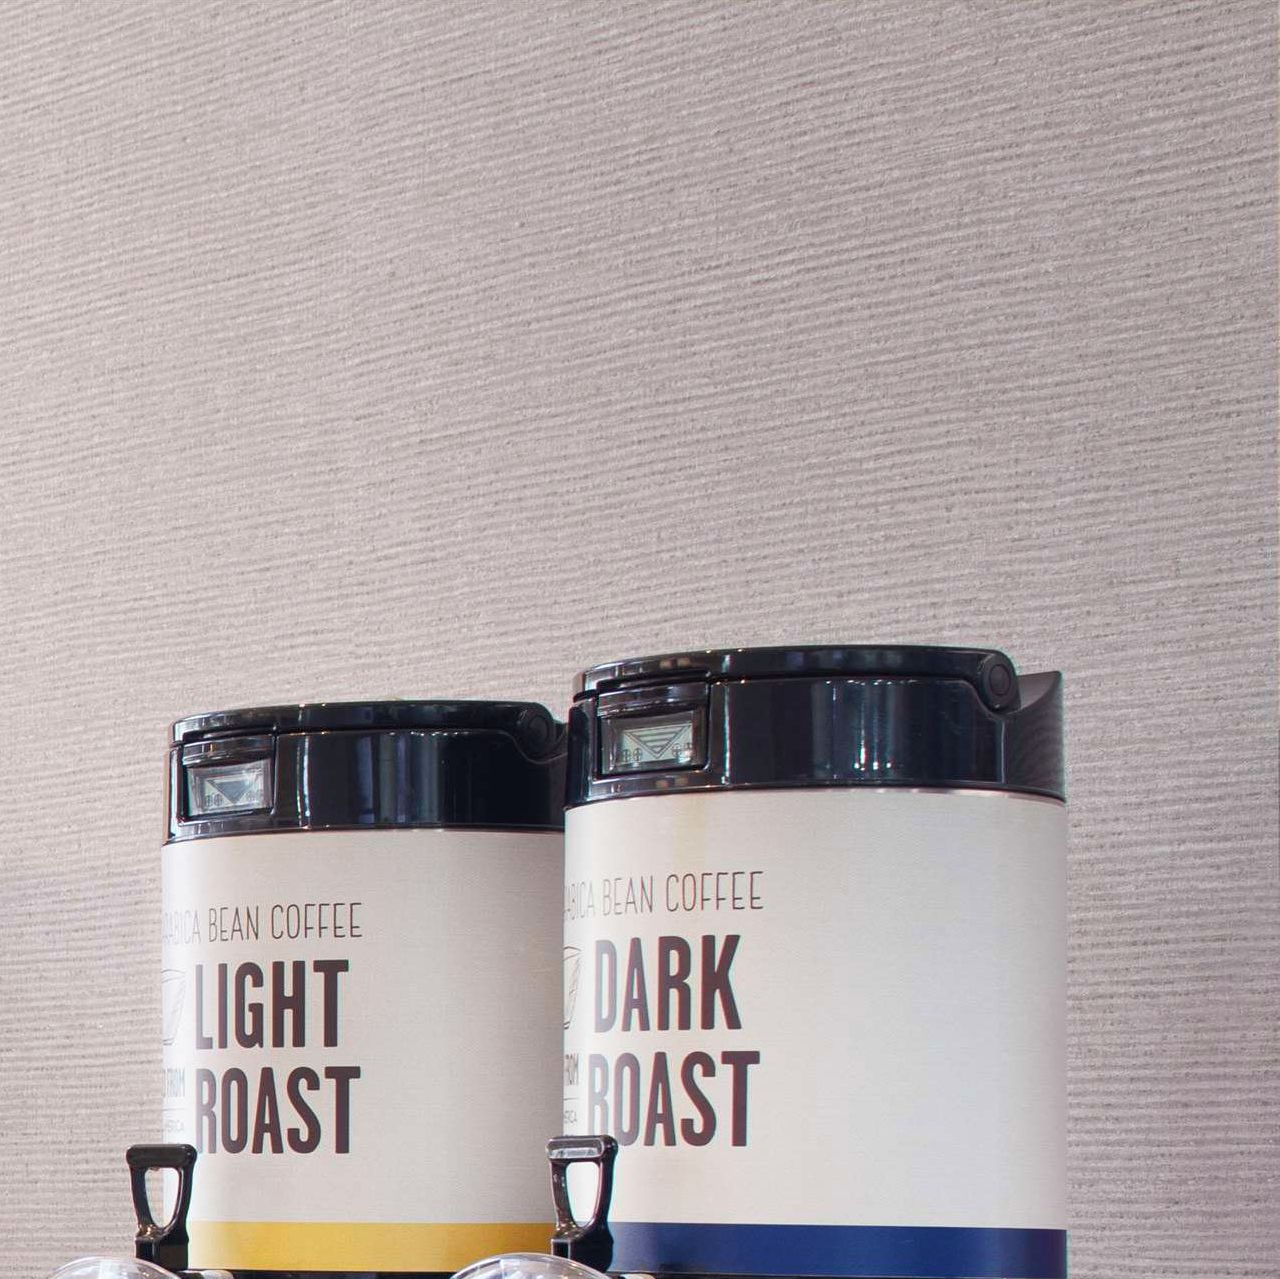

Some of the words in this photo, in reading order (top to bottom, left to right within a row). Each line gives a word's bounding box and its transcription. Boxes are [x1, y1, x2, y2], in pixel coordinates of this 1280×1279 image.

[209, 905, 260, 943] BEAN
[271, 902, 362, 940] COFFEE
[603, 876, 654, 917] BEAN
[665, 871, 764, 912] COFFEE
[195, 959, 349, 1050] LIGHT
[594, 934, 742, 1033] DARK
[195, 1065, 361, 1155] ROAST
[588, 1050, 761, 1148] ROAST
